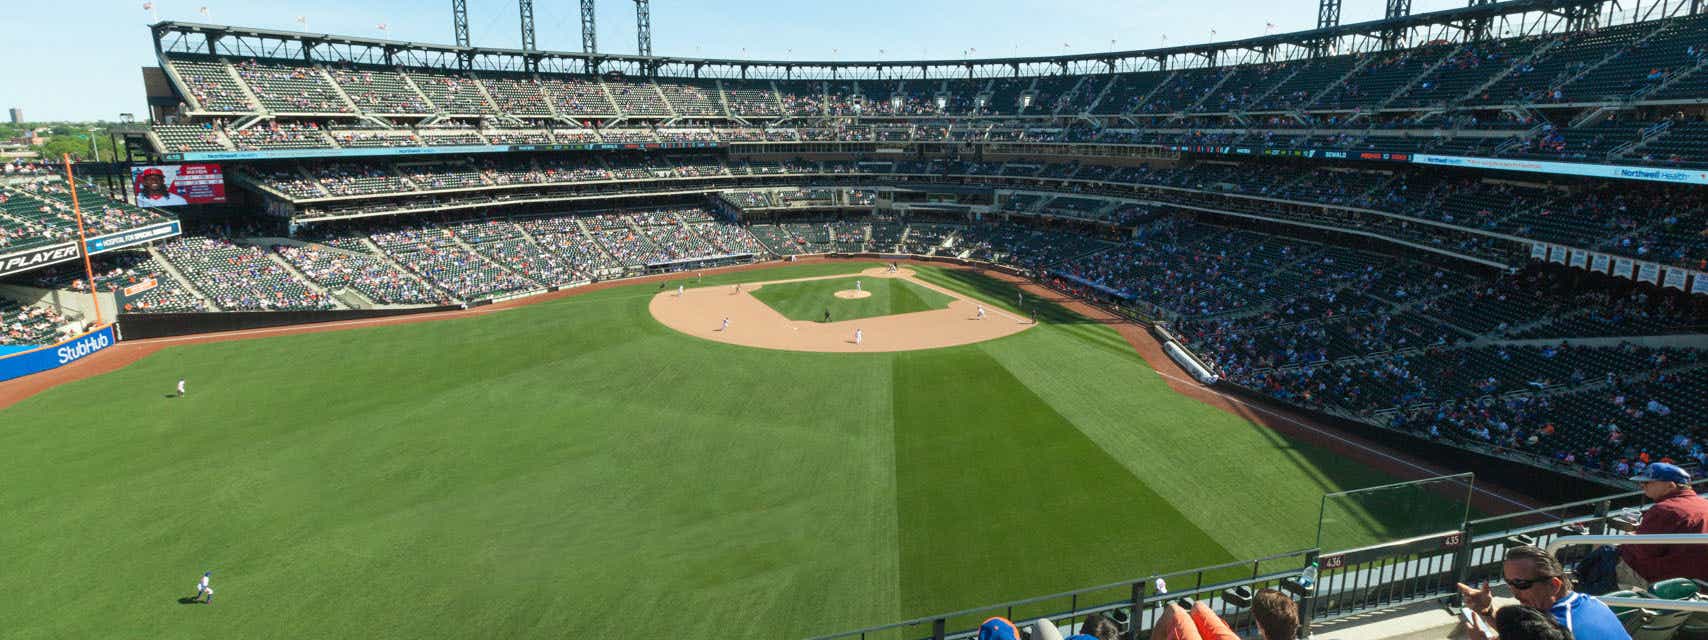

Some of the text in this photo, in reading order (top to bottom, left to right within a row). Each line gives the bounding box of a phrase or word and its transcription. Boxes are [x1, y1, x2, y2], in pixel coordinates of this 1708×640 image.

[1622, 169, 1688, 181] Northwell Health
[5, 246, 76, 271] PLAYER
[58, 333, 109, 364] StubHub
[1445, 535, 1459, 545] 435
[1326, 557, 1341, 568] 436
